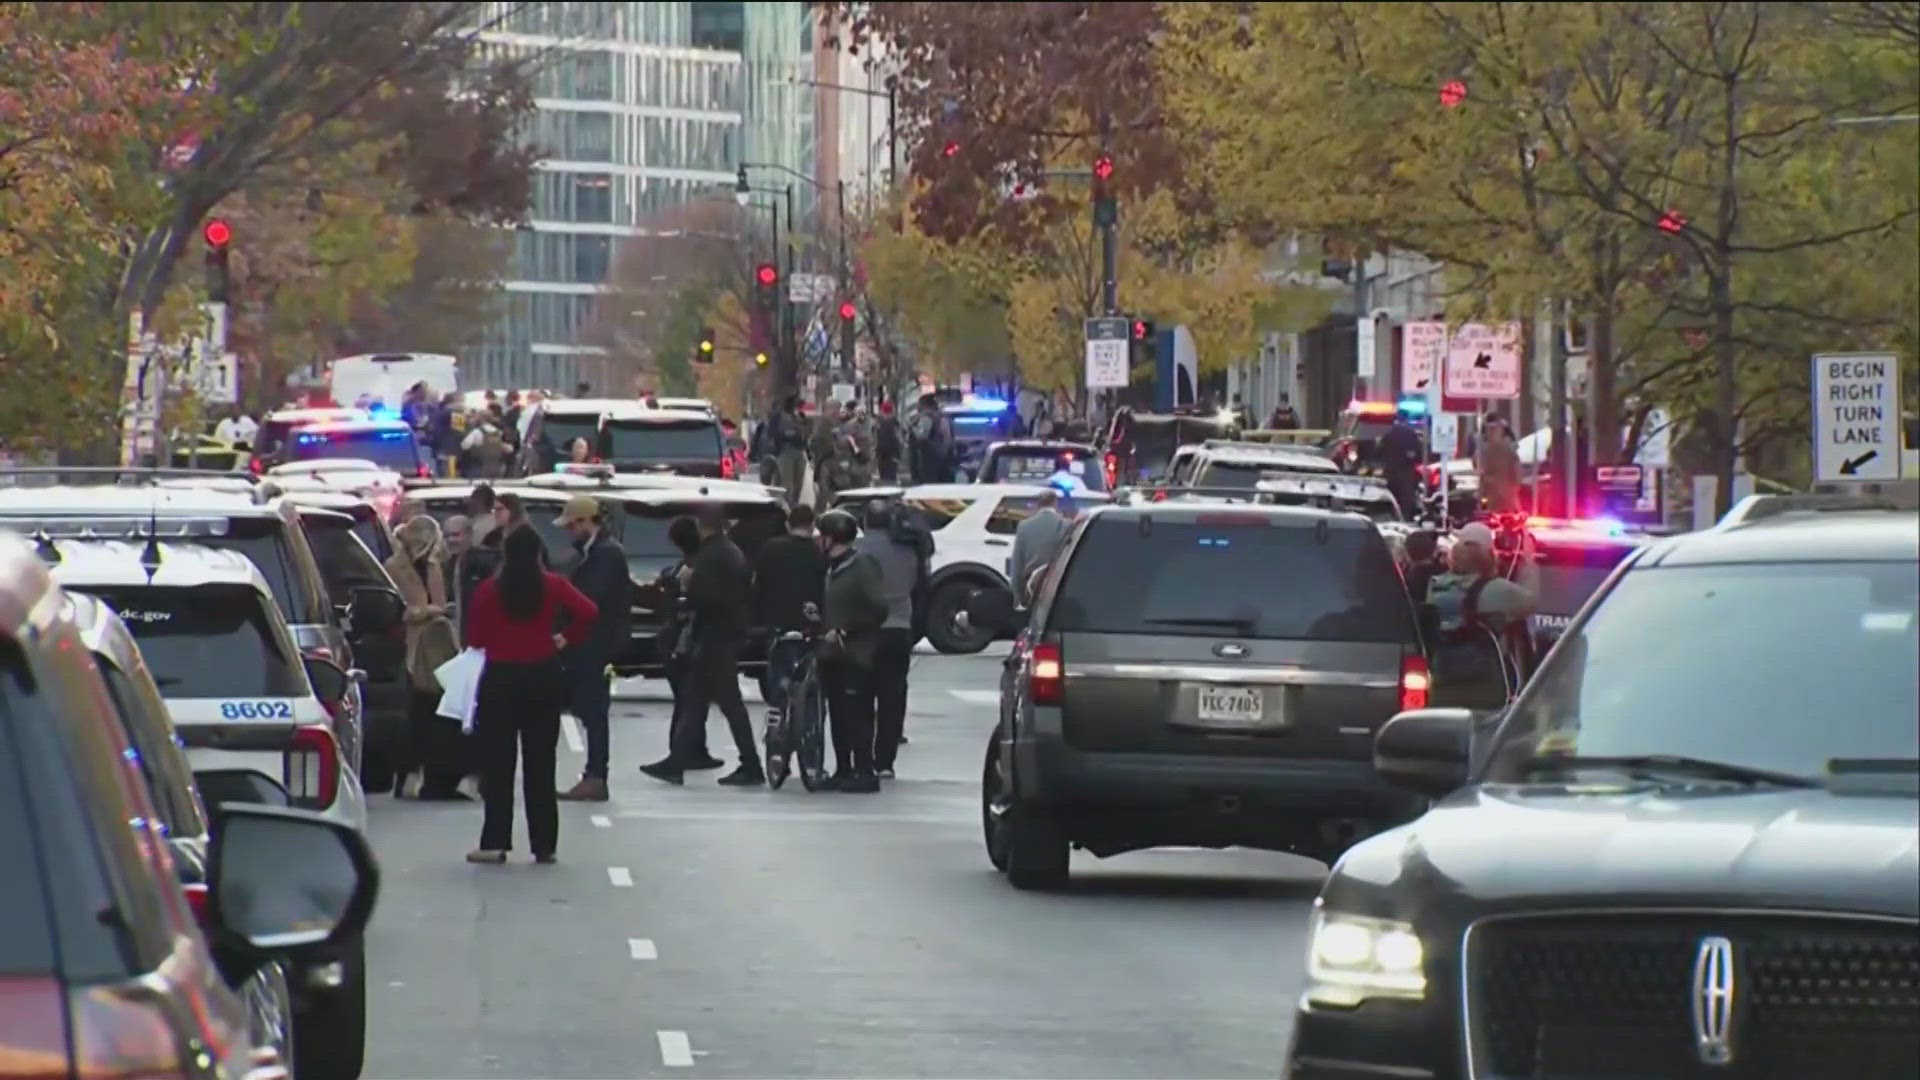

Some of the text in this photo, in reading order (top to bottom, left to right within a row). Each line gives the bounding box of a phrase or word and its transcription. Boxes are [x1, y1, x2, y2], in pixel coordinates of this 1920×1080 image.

[1828, 362, 1884, 379] BEGIN
[1829, 383, 1883, 401] RIGHT
[1834, 406, 1883, 422] TURN
[1833, 427, 1883, 445] LANE
[220, 701, 292, 720] 8602
